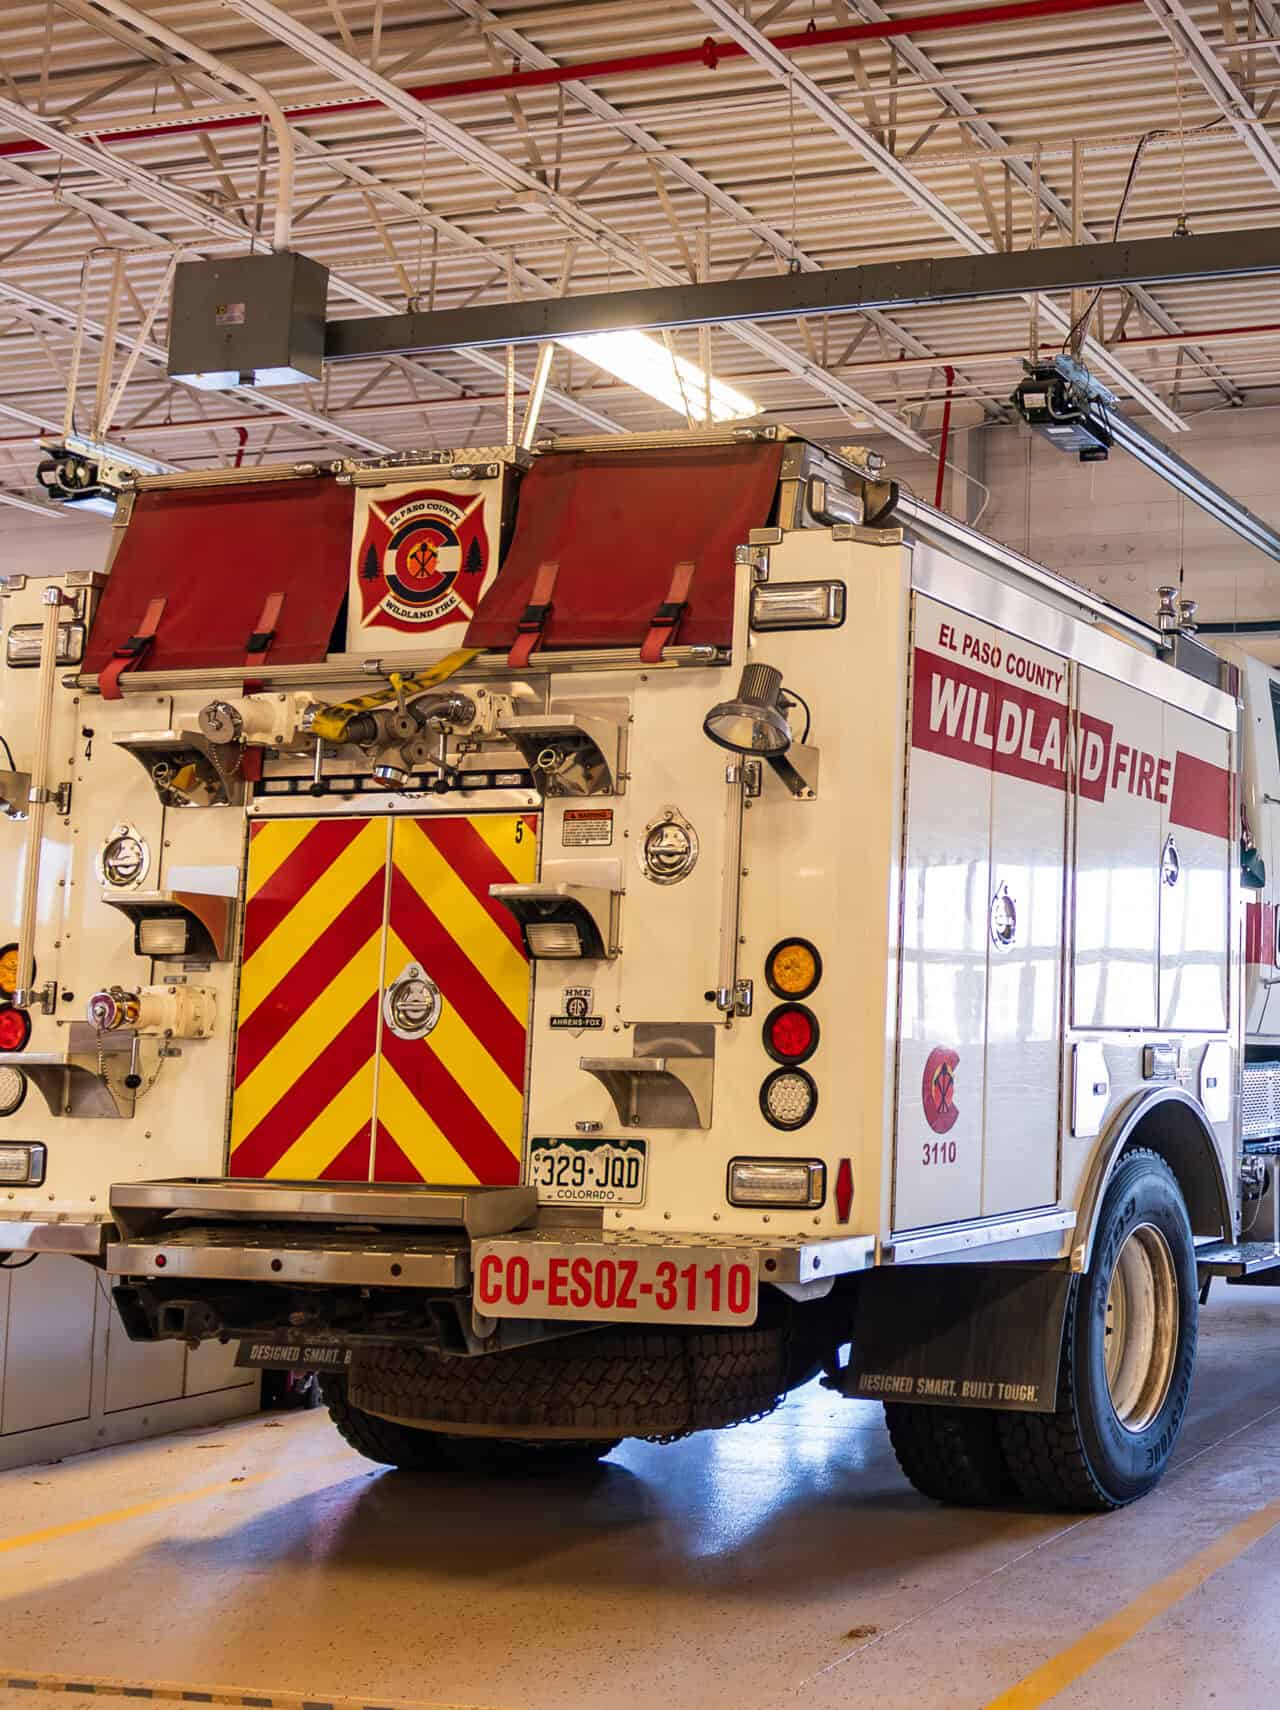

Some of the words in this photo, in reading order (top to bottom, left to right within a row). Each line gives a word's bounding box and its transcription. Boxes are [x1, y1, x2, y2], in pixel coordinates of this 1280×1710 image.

[389, 515, 401, 526] EL
[426, 503, 461, 521] COUNTY
[385, 599, 433, 619] WILDLAND
[435, 596, 457, 614] FIRE
[938, 623, 957, 651] EL
[962, 634, 1001, 668] PASO
[1006, 652, 1063, 693] COUNTY
[929, 672, 1104, 782] WILDLAND
[1111, 742, 1172, 804] FIRE
[515, 820, 523, 843] 5
[565, 989, 592, 997] HME
[922, 1141, 956, 1165] 3110
[557, 1189, 615, 1200] COLORADO
[250, 1344, 300, 1361] DESIGNED
[859, 1373, 913, 1393] DESIGNED
[917, 1377, 957, 1397] SMART.
[962, 1381, 994, 1399] BUILT
